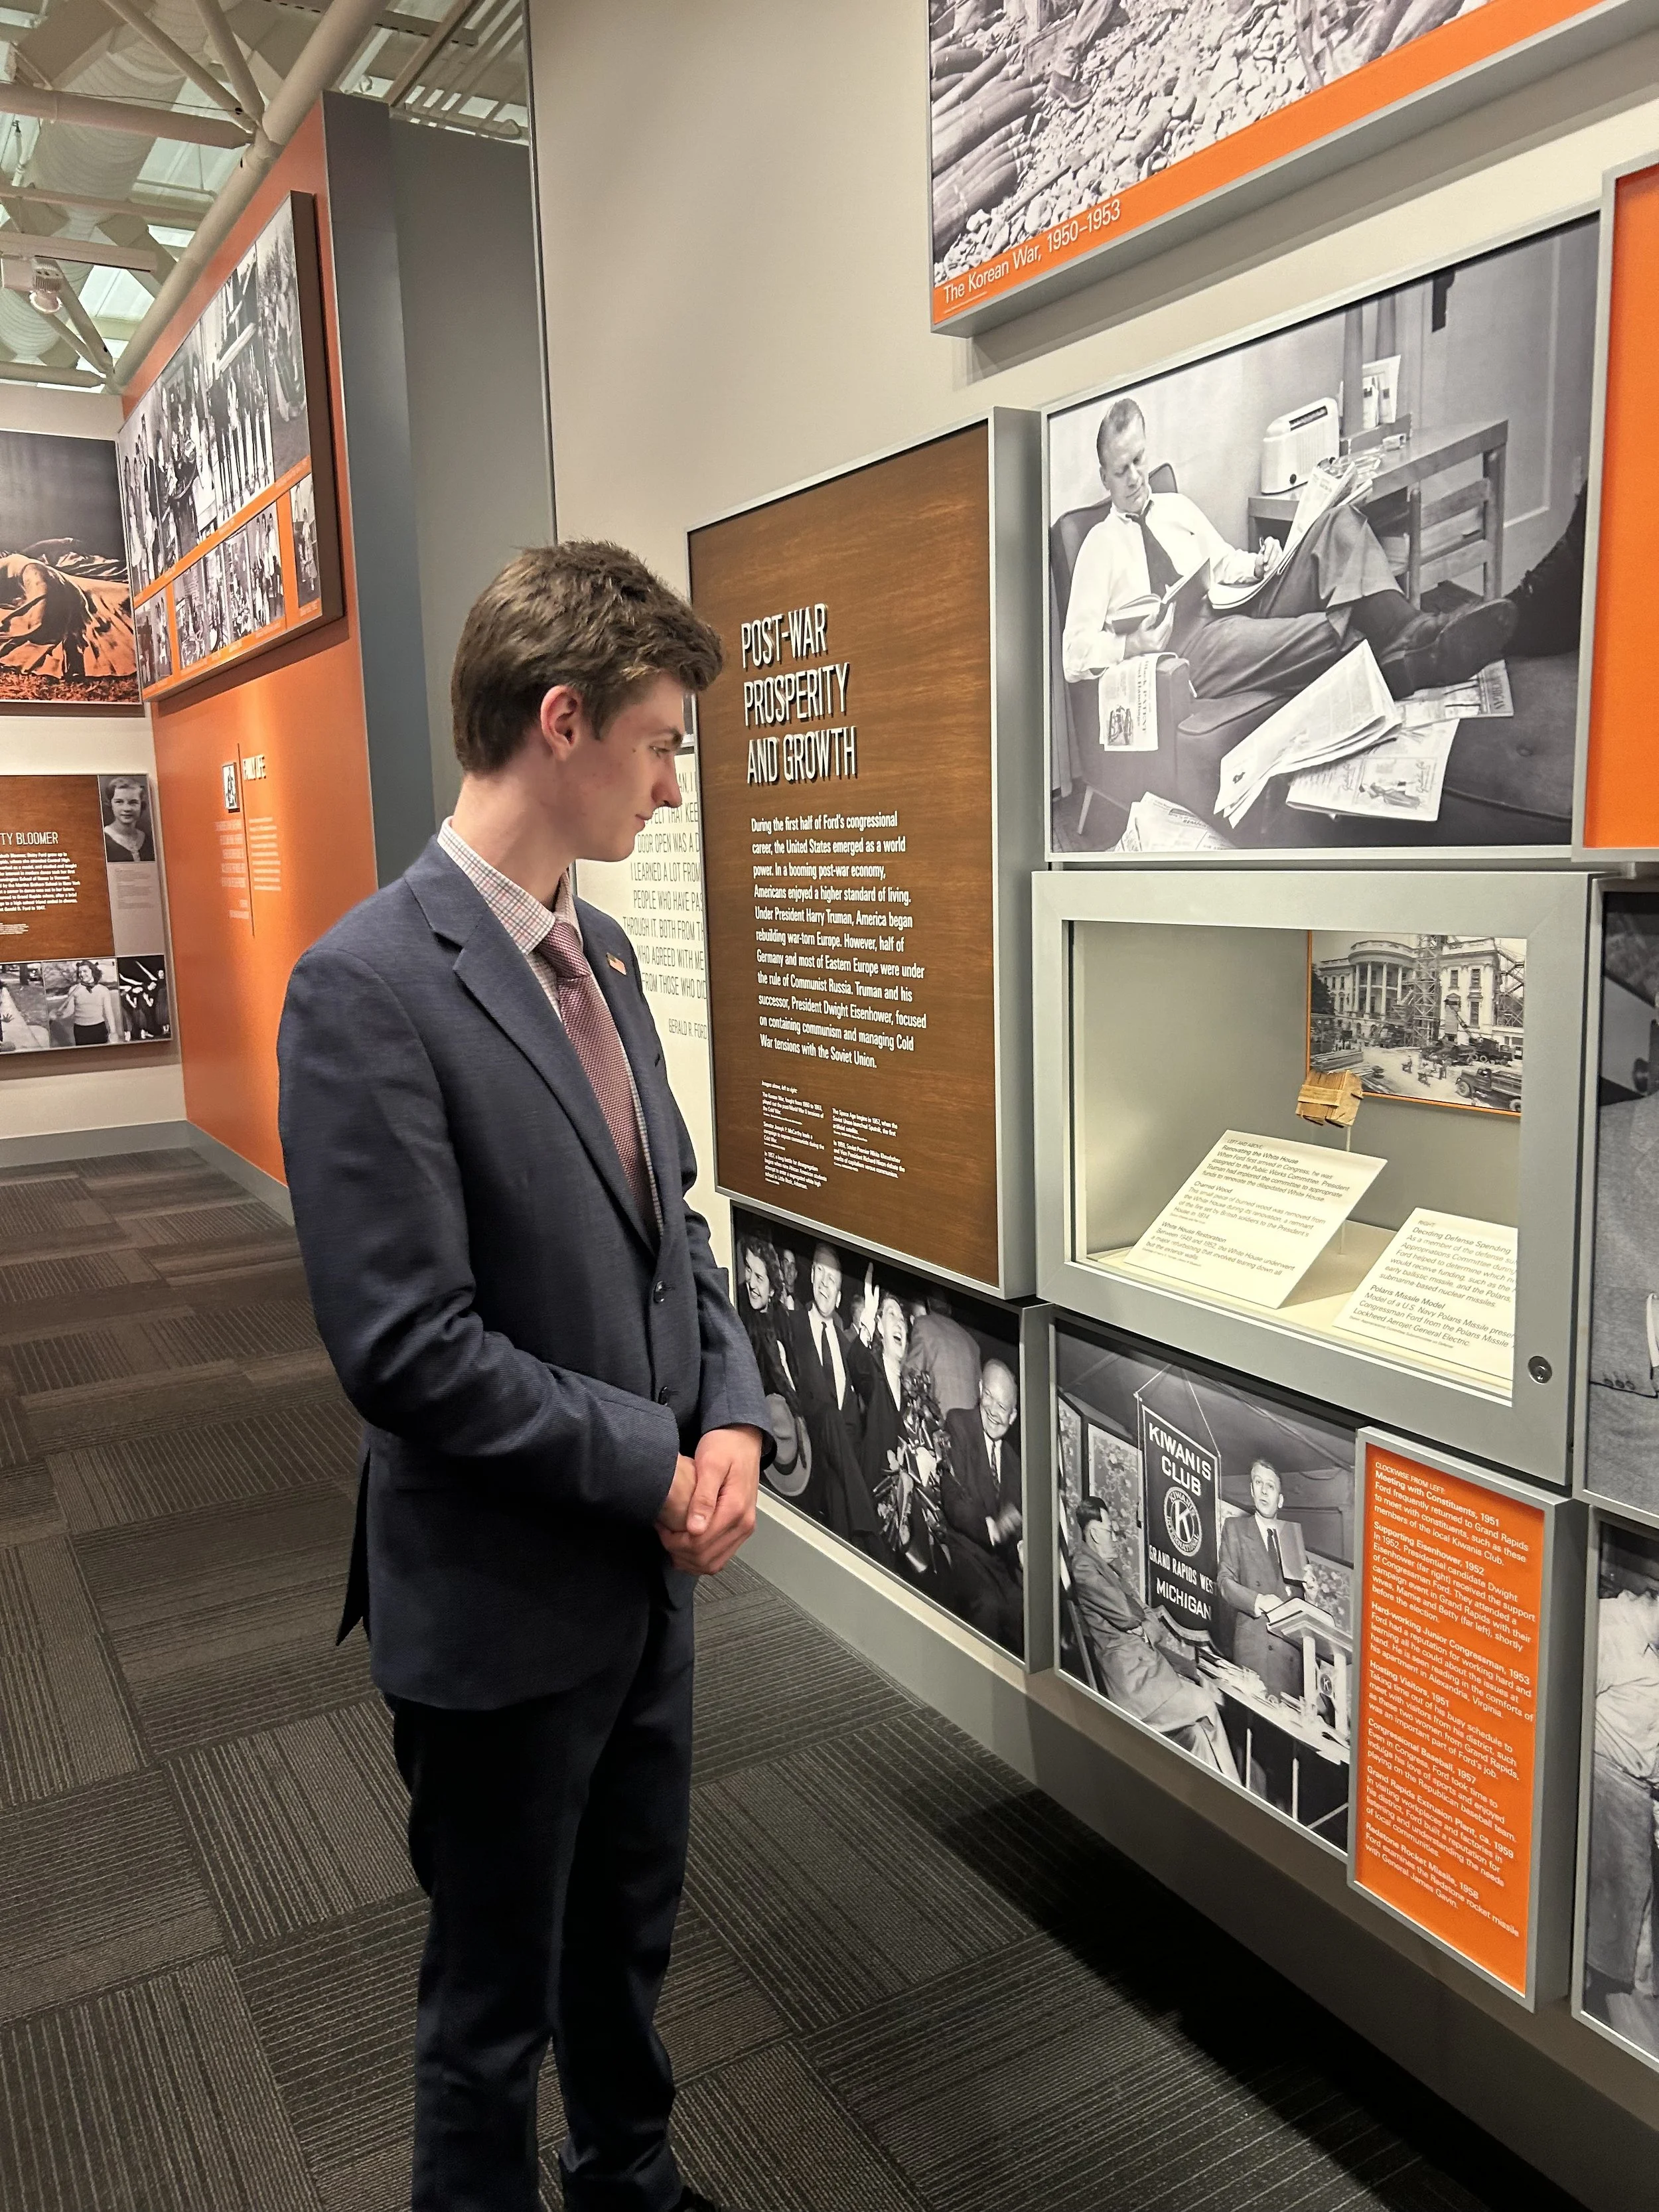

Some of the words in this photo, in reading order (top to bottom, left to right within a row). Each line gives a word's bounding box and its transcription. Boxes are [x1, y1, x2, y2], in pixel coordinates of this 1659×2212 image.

[944, 282, 965, 304] The
[968, 261, 1009, 293] Korean
[1013, 244, 1042, 271] War,
[741, 603, 828, 669] POST-WAR
[744, 662, 850, 727] PROSPERITY
[747, 737, 780, 784] AND
[783, 726, 857, 782] GROWTH
[751, 818, 772, 835] During
[772, 817, 784, 832] the
[784, 816, 799, 831] first
[799, 814, 813, 830] half
[814, 814, 822, 830] of
[823, 814, 845, 830] Ford's
[846, 810, 898, 832] congressional
[15, 831, 59, 846] BLOOMER
[637, 832, 654, 853] DOOR
[654, 833, 672, 853] OPEN
[672, 832, 687, 853] WAS
[688, 832, 694, 853] A
[752, 843, 773, 855] career,
[774, 840, 785, 854] the
[786, 839, 808, 854] United
[809, 838, 831, 853] States
[832, 837, 864, 856] emerged
[865, 840, 875, 853] as
[876, 840, 881, 853] a
[883, 836, 906, 853] world
[634, 861, 662, 882] LEARNED
[663, 861, 669, 882] A
[668, 861, 681, 882] LOT
[753, 865, 774, 879] power.
[774, 862, 782, 876] In
[783, 865, 788, 877] a
[788, 861, 818, 880] booming
[818, 863, 850, 880] post-war
[851, 865, 886, 881] economy,
[633, 889, 657, 910] PEOPLE
[657, 890, 672, 911] WHO
[672, 891, 690, 911] HAVE
[754, 884, 787, 899] Americans
[788, 885, 813, 903] enjoyed
[814, 889, 819, 900] a
[820, 885, 843, 904] higher
[843, 886, 876, 902] standard
[877, 886, 886, 902] of
[887, 887, 911, 907] living.
[622, 916, 650, 937] THROUGH
[658, 919, 676, 939] BOTH
[677, 920, 695, 940] FROM
[755, 905, 774, 921] Under
[774, 907, 805, 922] President
[806, 908, 825, 926] Harry
[825, 909, 854, 926] Truman,
[855, 910, 887, 926] America
[889, 911, 913, 931] began
[755, 928, 786, 946] rebuilding
[787, 932, 816, 945] war-torn
[816, 931, 842, 950] Europe.
[843, 932, 877, 952] However,
[879, 935, 895, 952] half
[896, 936, 904, 952] of
[636, 944, 650, 965] WHO
[651, 946, 676, 968] AGREED
[676, 948, 693, 970] WITH
[694, 950, 704, 971] ME
[757, 948, 784, 968] Germany
[784, 952, 797, 966] and
[798, 955, 816, 968] most
[816, 954, 824, 969] of
[825, 954, 851, 972] Eastern
[853, 957, 879, 977] Europe
[879, 964, 900, 976] were
[901, 962, 925, 979] under
[658, 974, 680, 996] THOSE
[680, 977, 695, 998] WHO
[757, 970, 768, 984] the
[768, 972, 781, 986] rule
[782, 973, 790, 987] of
[790, 974, 828, 992] Communist
[828, 978, 853, 995] Russia.
[854, 981, 883, 999] Truman
[884, 986, 899, 1001] and
[901, 986, 913, 1002] his
[758, 995, 790, 1011] successor,
[791, 995, 822, 1014] President
[823, 999, 849, 1020] Dwight
[850, 1003, 894, 1026] Eisenhower,
[895, 1009, 926, 1029] focused
[668, 1017, 687, 1036] GERALD
[693, 1022, 707, 1040] FORD
[759, 1015, 768, 1027] on
[768, 1017, 801, 1035] containing
[802, 1023, 842, 1039] communism
[843, 1027, 857, 1042] and
[858, 1031, 895, 1051] managing
[896, 1033, 914, 1051] Cold
[759, 1033, 774, 1049] War
[774, 1037, 800, 1054] tensions
[801, 1042, 817, 1057] with
[818, 1044, 830, 1059] the
[830, 1046, 853, 1064] Soviet
[853, 1050, 877, 1069] Union.
[1411, 1226, 1444, 1240] Deciding
[1444, 1234, 1475, 1246] Defense
[1475, 1240, 1511, 1255] Spending
[1370, 1284, 1394, 1296] Polaris
[1394, 1291, 1420, 1303] Missile
[1420, 1297, 1446, 1309] Model
[1149, 1422, 1212, 1481] KIWANIS
[1161, 1455, 1202, 1497] CLUB
[1375, 1469, 1406, 1491] Meeting
[1407, 1485, 1425, 1497] with
[1480, 1512, 1500, 1527] 1951
[1374, 1520, 1415, 1547] Supporting
[1465, 1560, 1484, 1576] 1952
[1149, 1544, 1171, 1571] GRAND
[1172, 1558, 1197, 1586] RAPIDS
[1156, 1577, 1212, 1621] MICHIGAN
[1370, 1659, 1398, 1682] Hosting
[1431, 1692, 1449, 1708] 1951
[1368, 1718, 1419, 1752] Congressional
[1457, 1768, 1477, 1784] 1957
[1365, 1844, 1380, 1858] with
[1382, 1853, 1409, 1876] General
[1410, 1873, 1434, 1893] James
